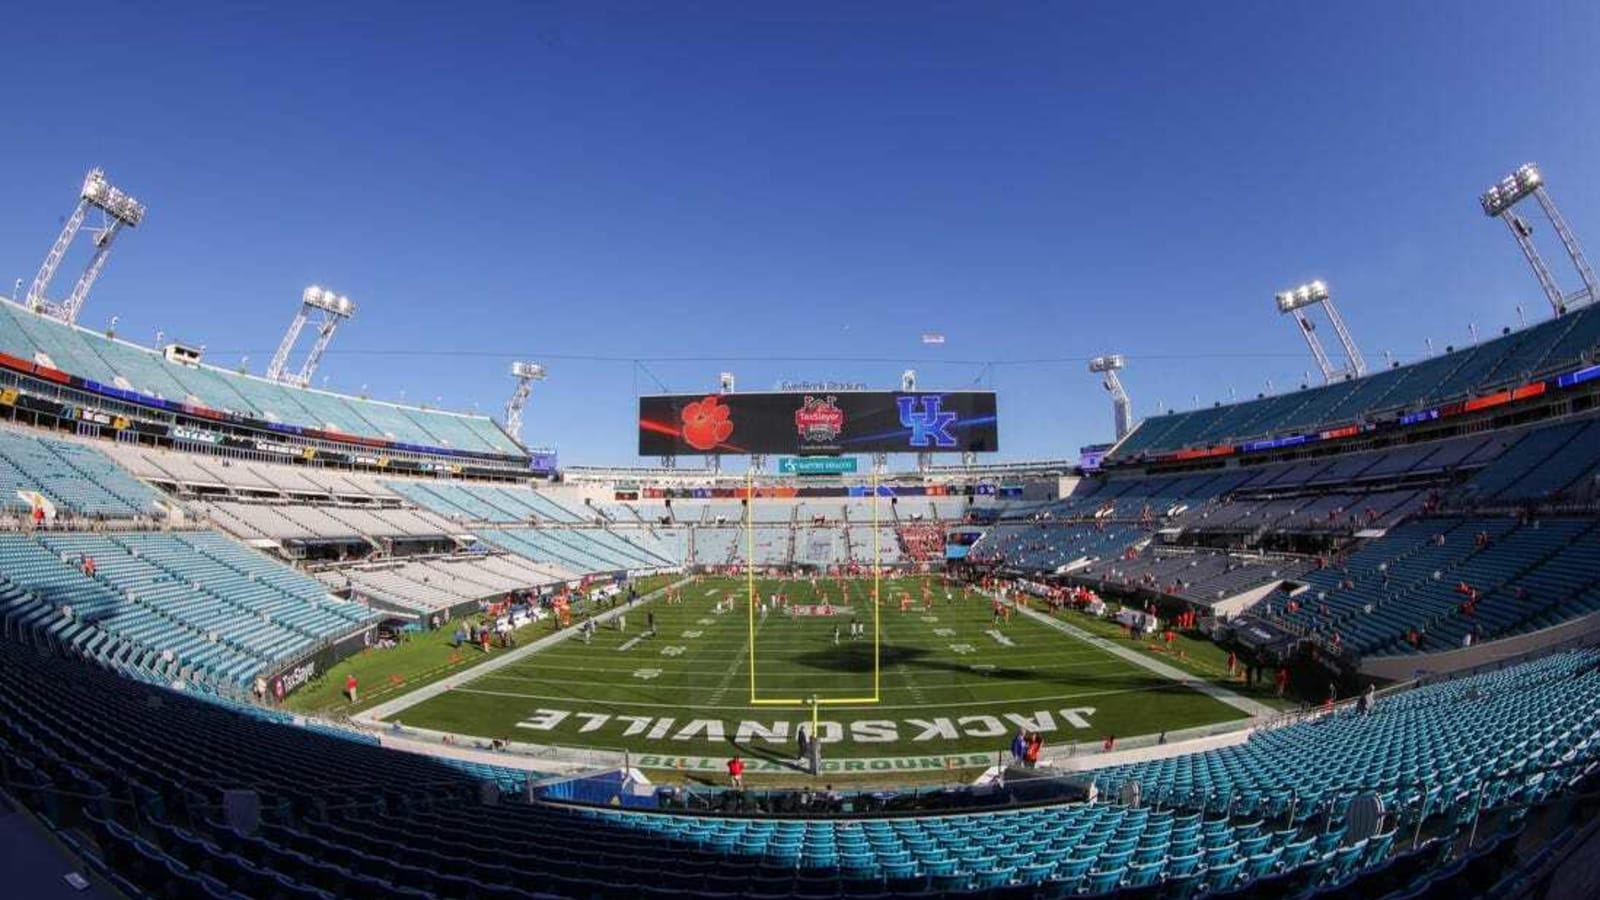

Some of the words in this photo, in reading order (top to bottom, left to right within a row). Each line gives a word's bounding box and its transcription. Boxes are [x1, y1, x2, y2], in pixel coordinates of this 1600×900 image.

[897, 395, 956, 446] UK
[515, 704, 1096, 743] JACKSONVILLE
[820, 753, 991, 772] GROUNDS
